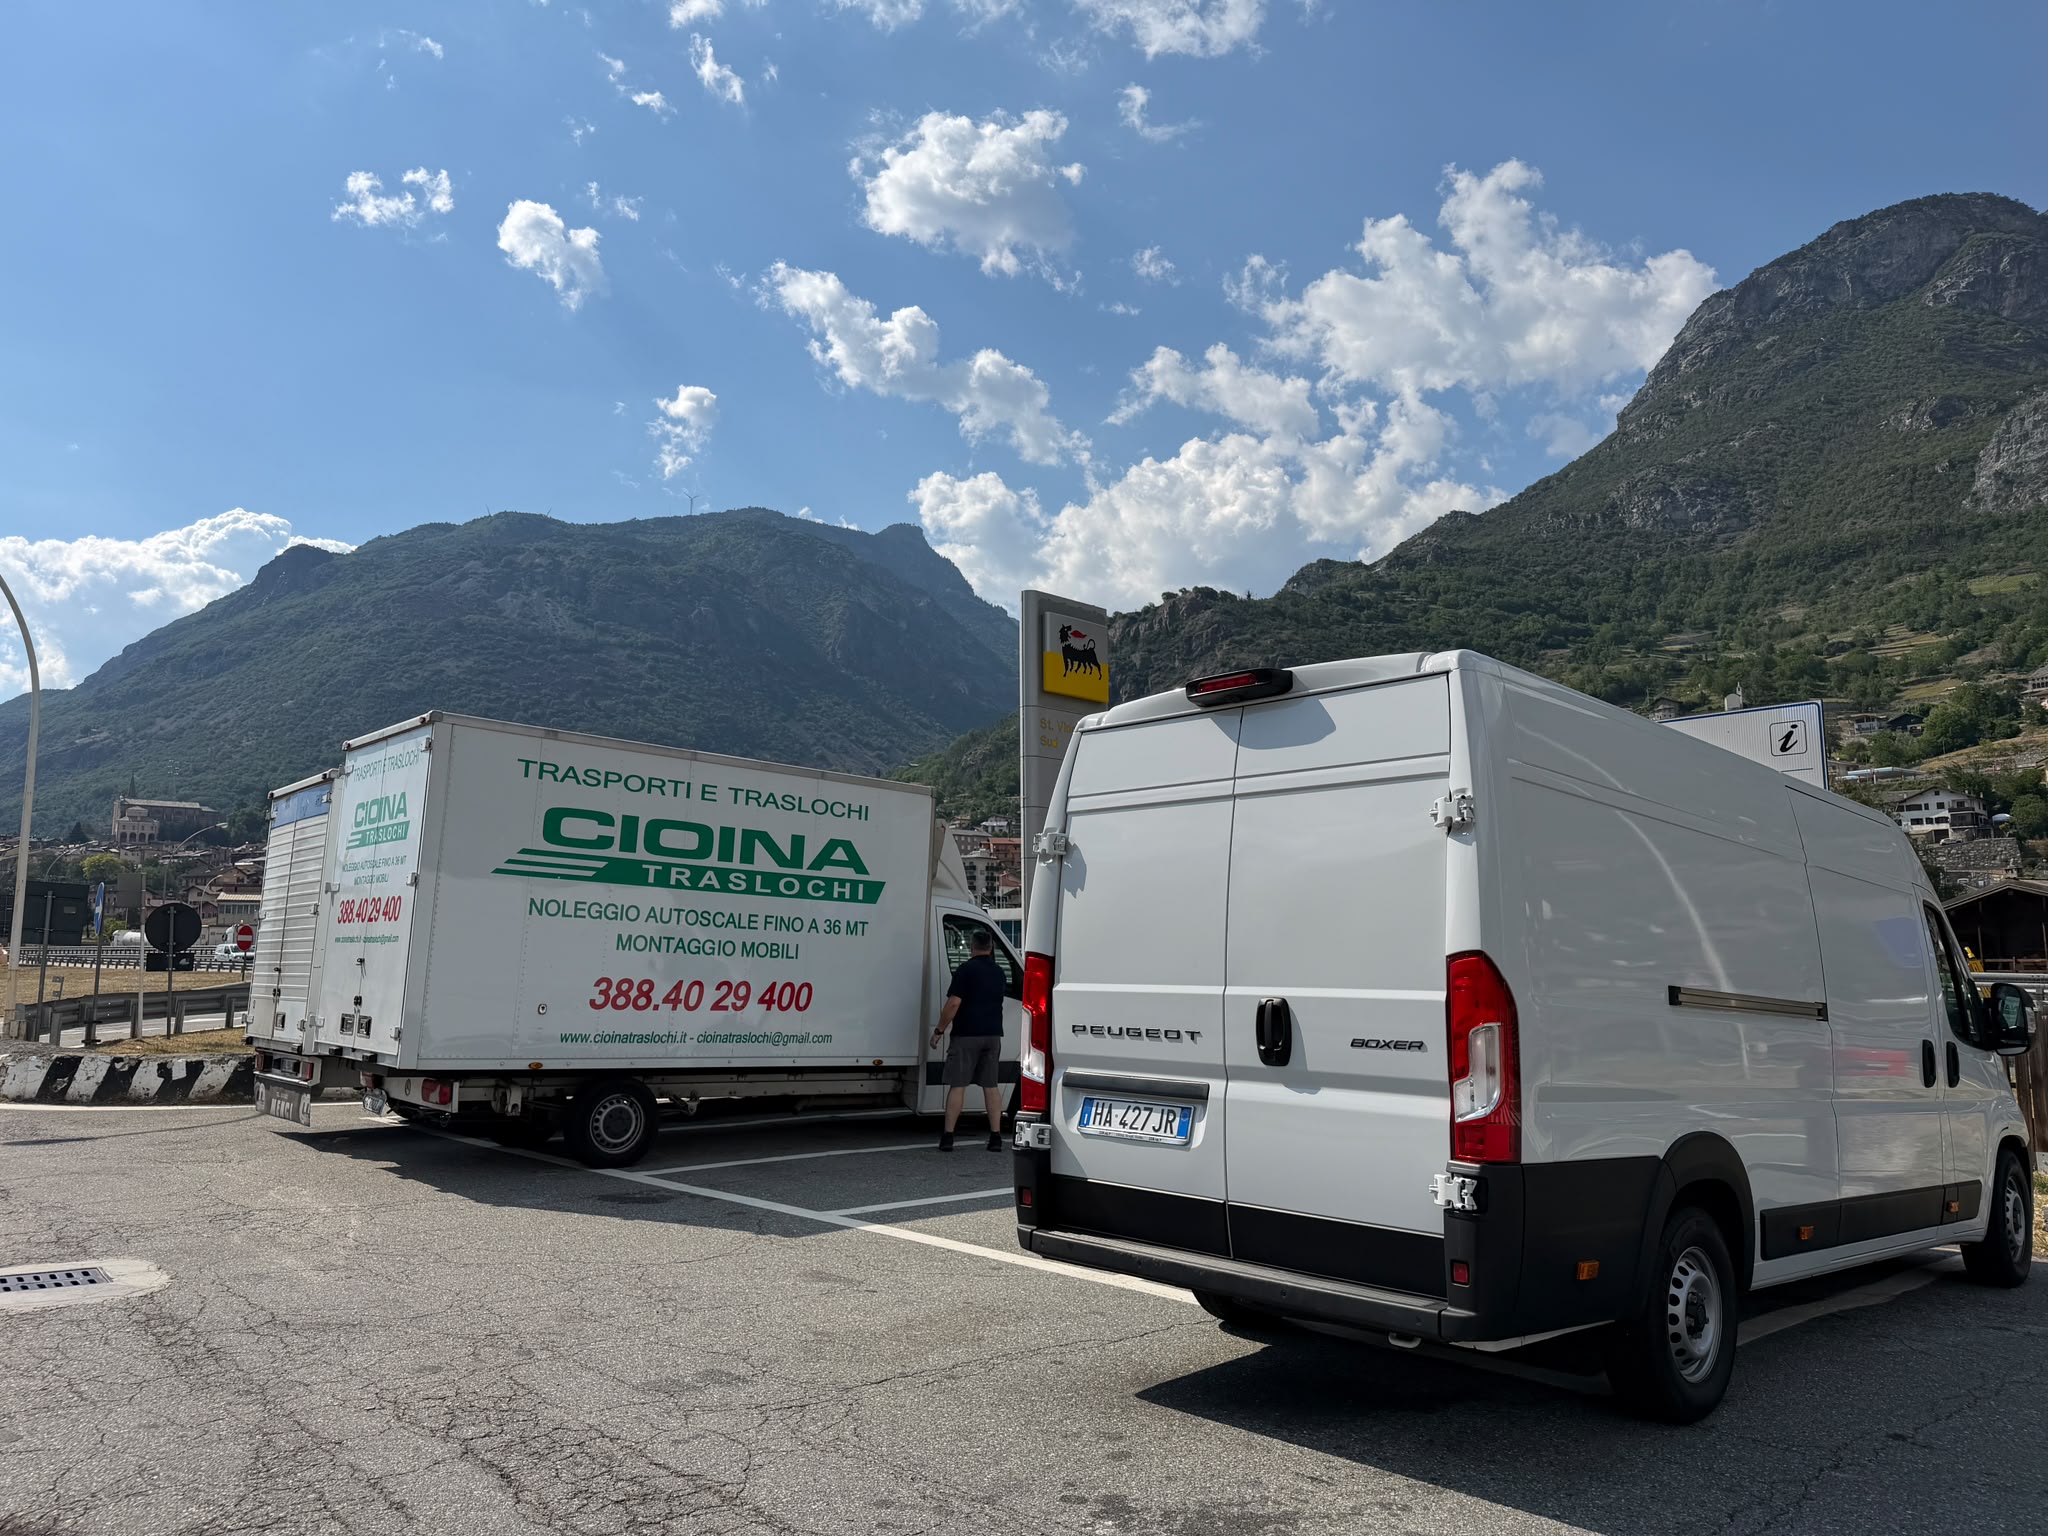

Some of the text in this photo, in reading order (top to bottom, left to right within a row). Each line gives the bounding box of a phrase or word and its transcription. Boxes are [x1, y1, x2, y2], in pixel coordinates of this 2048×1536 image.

[353, 759, 382, 781] TRASPORTI
[517, 758, 870, 821] TRASPORTI E TRASLOCHI
[354, 791, 408, 828] CIOINA
[366, 824, 406, 844] TRASLOCHI
[542, 806, 871, 876] CIOINA
[642, 863, 865, 900] TRASLOCHI
[338, 895, 402, 924] 388.40 29 400
[528, 898, 868, 937] NOLEGGIO AUTOSCALE FINO A 36 MT
[616, 933, 799, 960] MONTAGGIO MOBILI
[588, 977, 814, 1012] 388.40 29 400
[559, 1031, 687, 1045] www.cioinatraslochi.it
[696, 1031, 833, 1047] cioinatraslochi@gmail.com
[1071, 1024, 1201, 1041] PEUGEOT
[1350, 1038, 1424, 1050] BOXER
[1092, 1101, 1113, 1127] HA
[1118, 1104, 1177, 1135] 427JR
